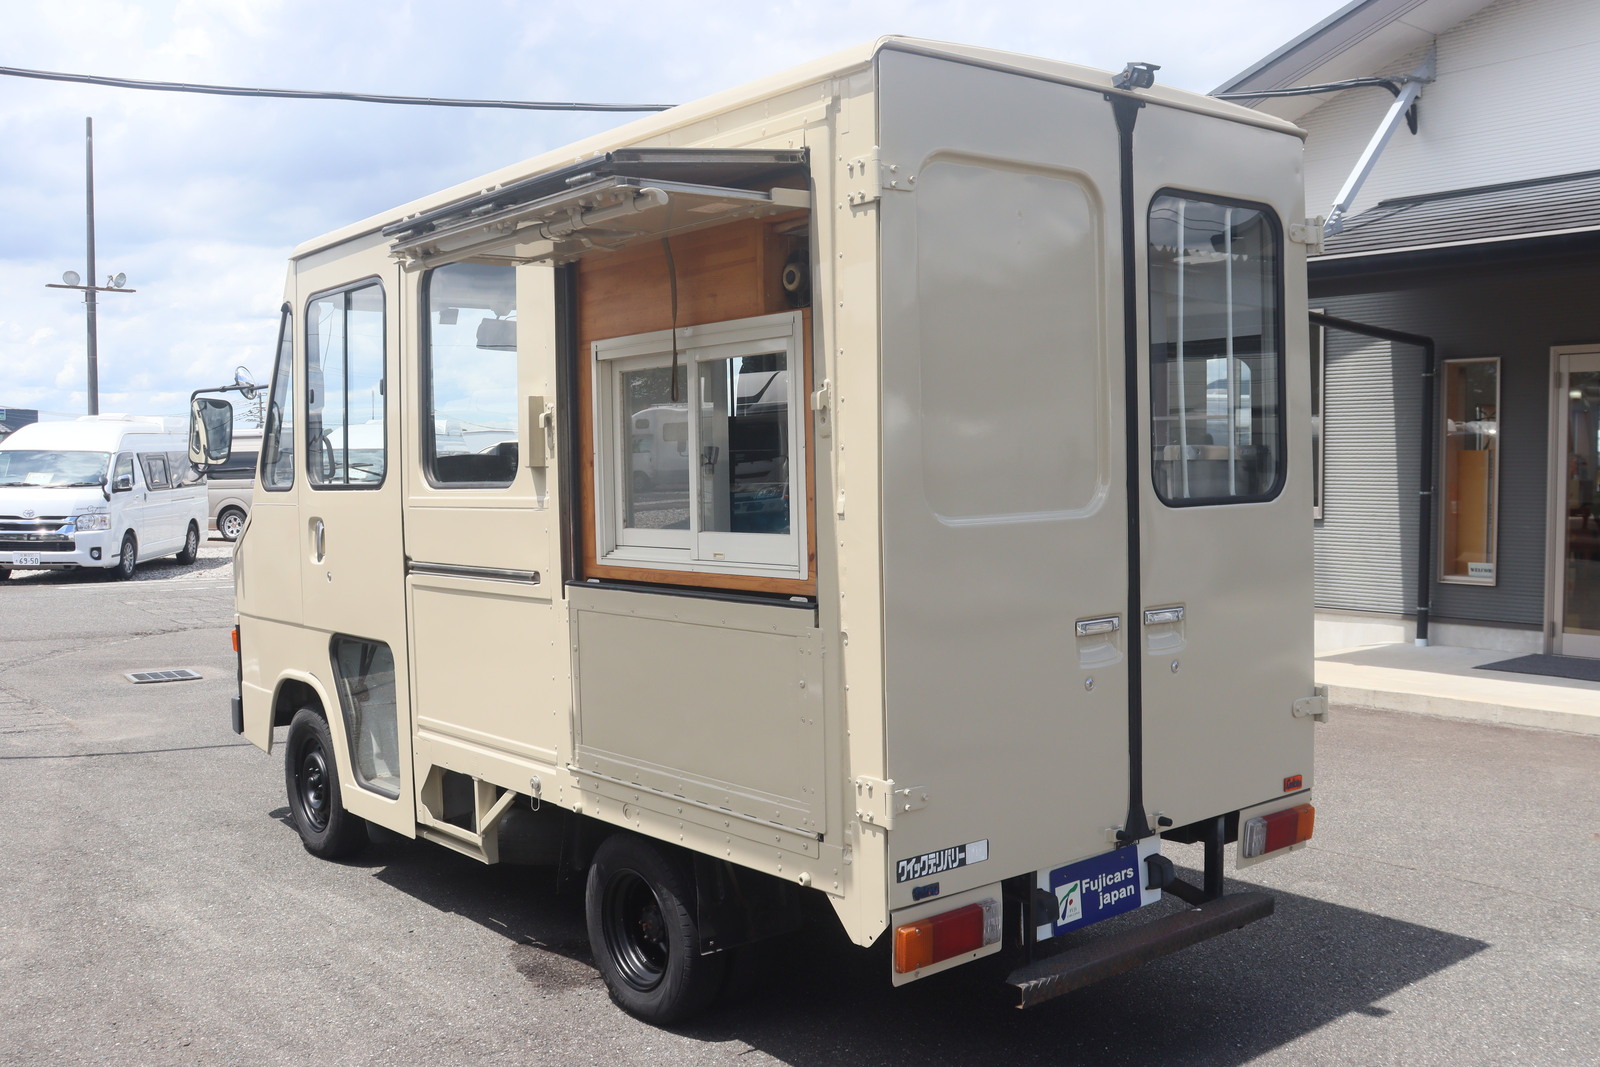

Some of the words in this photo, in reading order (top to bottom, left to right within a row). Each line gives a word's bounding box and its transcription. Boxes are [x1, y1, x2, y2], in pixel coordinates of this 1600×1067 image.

[898, 847, 965, 882] クイックデリバリー
[1082, 867, 1134, 893] Fujicars
[1098, 884, 1135, 909] japan
